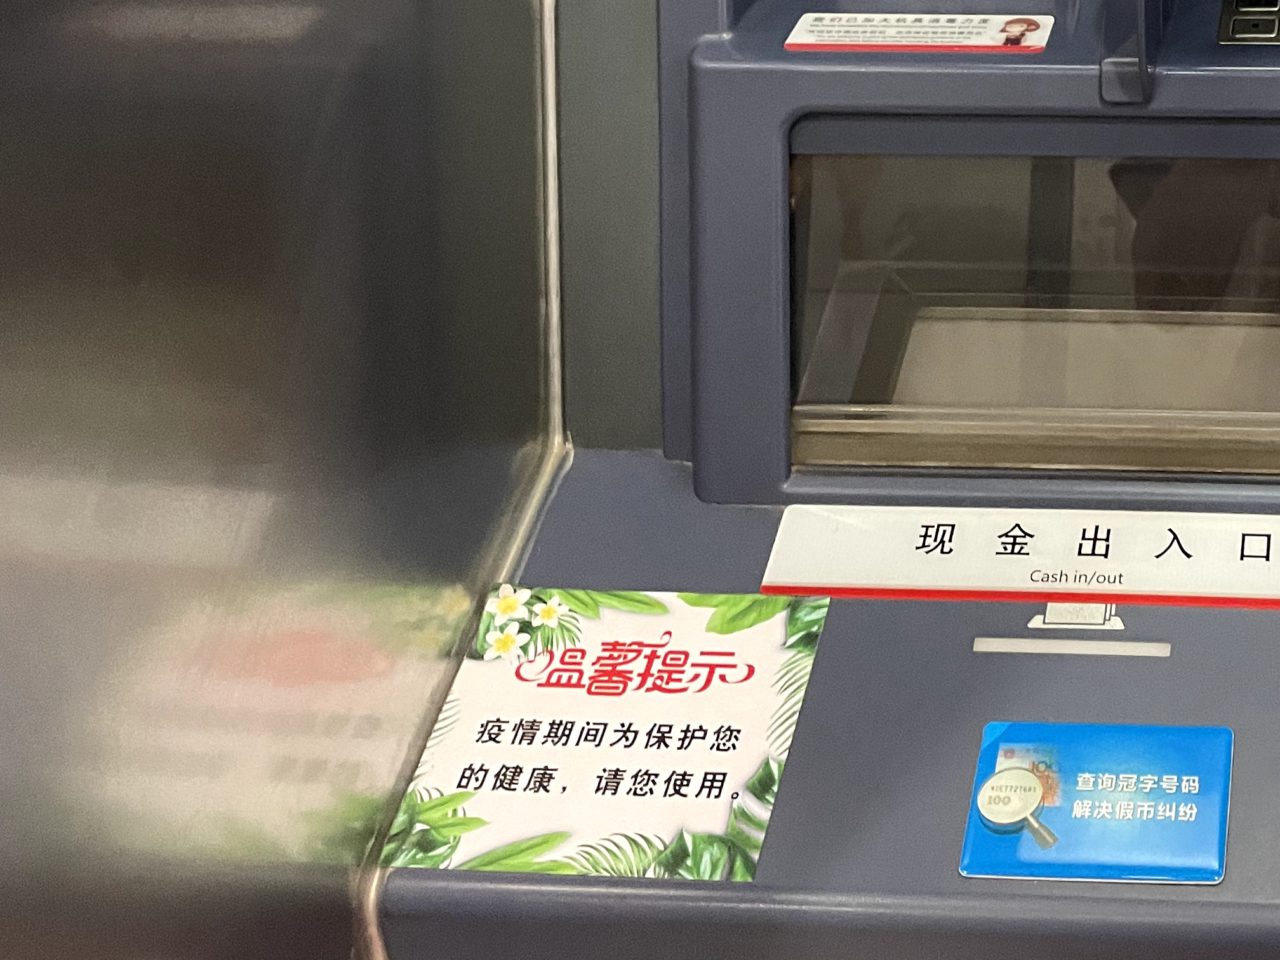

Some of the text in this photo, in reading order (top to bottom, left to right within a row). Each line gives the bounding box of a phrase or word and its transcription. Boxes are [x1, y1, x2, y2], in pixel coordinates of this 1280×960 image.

[916, 522, 1273, 563] 现金出入口
[1030, 569, 1125, 587] Cash in/out
[514, 630, 755, 697] 温馨提示
[475, 717, 742, 752] 疫情期间为保护您
[455, 764, 743, 801] 的健康，请您使用。
[1076, 773, 1201, 795] 查询冠字号码
[1072, 799, 1198, 822] 解决假币纠纷
